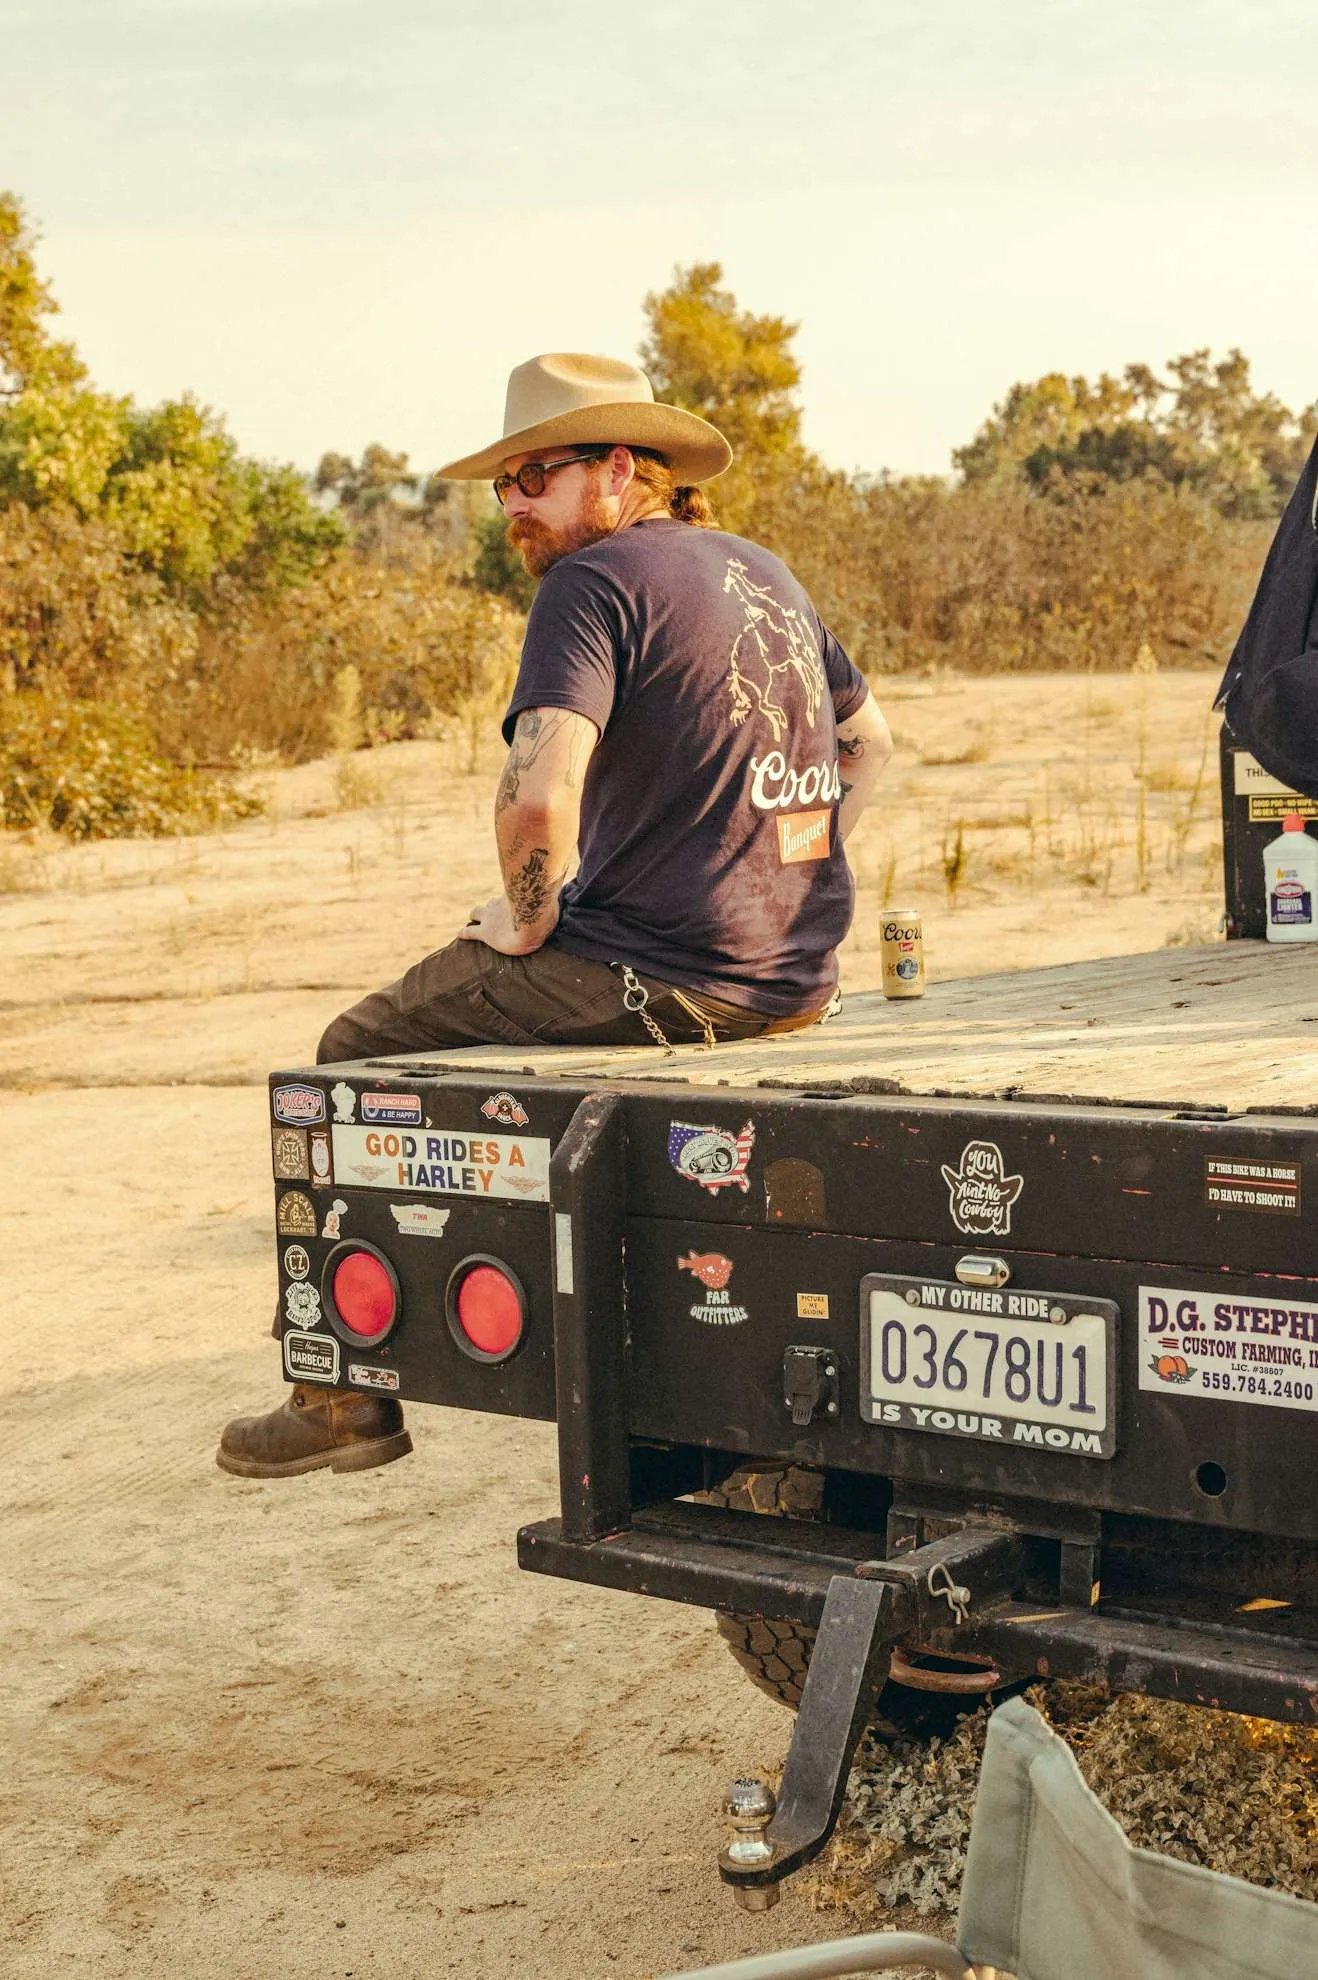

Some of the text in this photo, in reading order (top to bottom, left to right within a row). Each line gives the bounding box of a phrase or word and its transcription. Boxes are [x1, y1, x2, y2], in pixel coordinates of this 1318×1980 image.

[783, 816, 827, 858] Banquet
[883, 922, 922, 942] Coor
[387, 1111, 396, 1119] BE
[396, 1111, 416, 1120] HAPPY
[366, 1133, 526, 1168] GOD RIDES A
[398, 1162, 494, 1193] HARLEY
[1208, 1162, 1296, 1180] IF THIS BIKE WAS A HORSE
[959, 1199, 1004, 1225] Cowboy
[1220, 1189, 1243, 1203] HAVE
[1243, 1191, 1256, 1204] TO
[1256, 1192, 1284, 1207] SHOOT
[706, 1290, 730, 1305] FAR
[921, 1286, 1049, 1318] MY OTHER RIDE
[689, 1305, 749, 1325] OUTFITTERS
[1147, 1297, 1206, 1334] D.G.
[291, 1350, 333, 1369] BARBECUE
[881, 1319, 1097, 1415] 03678U1
[1182, 1336, 1237, 1360] CUSTOM
[1241, 1342, 1306, 1370] FARMING,
[1231, 1363, 1250, 1372] LIC.
[1202, 1371, 1313, 1401] 559.784.2400
[871, 1402, 1103, 1454] IS YOUR MOM
